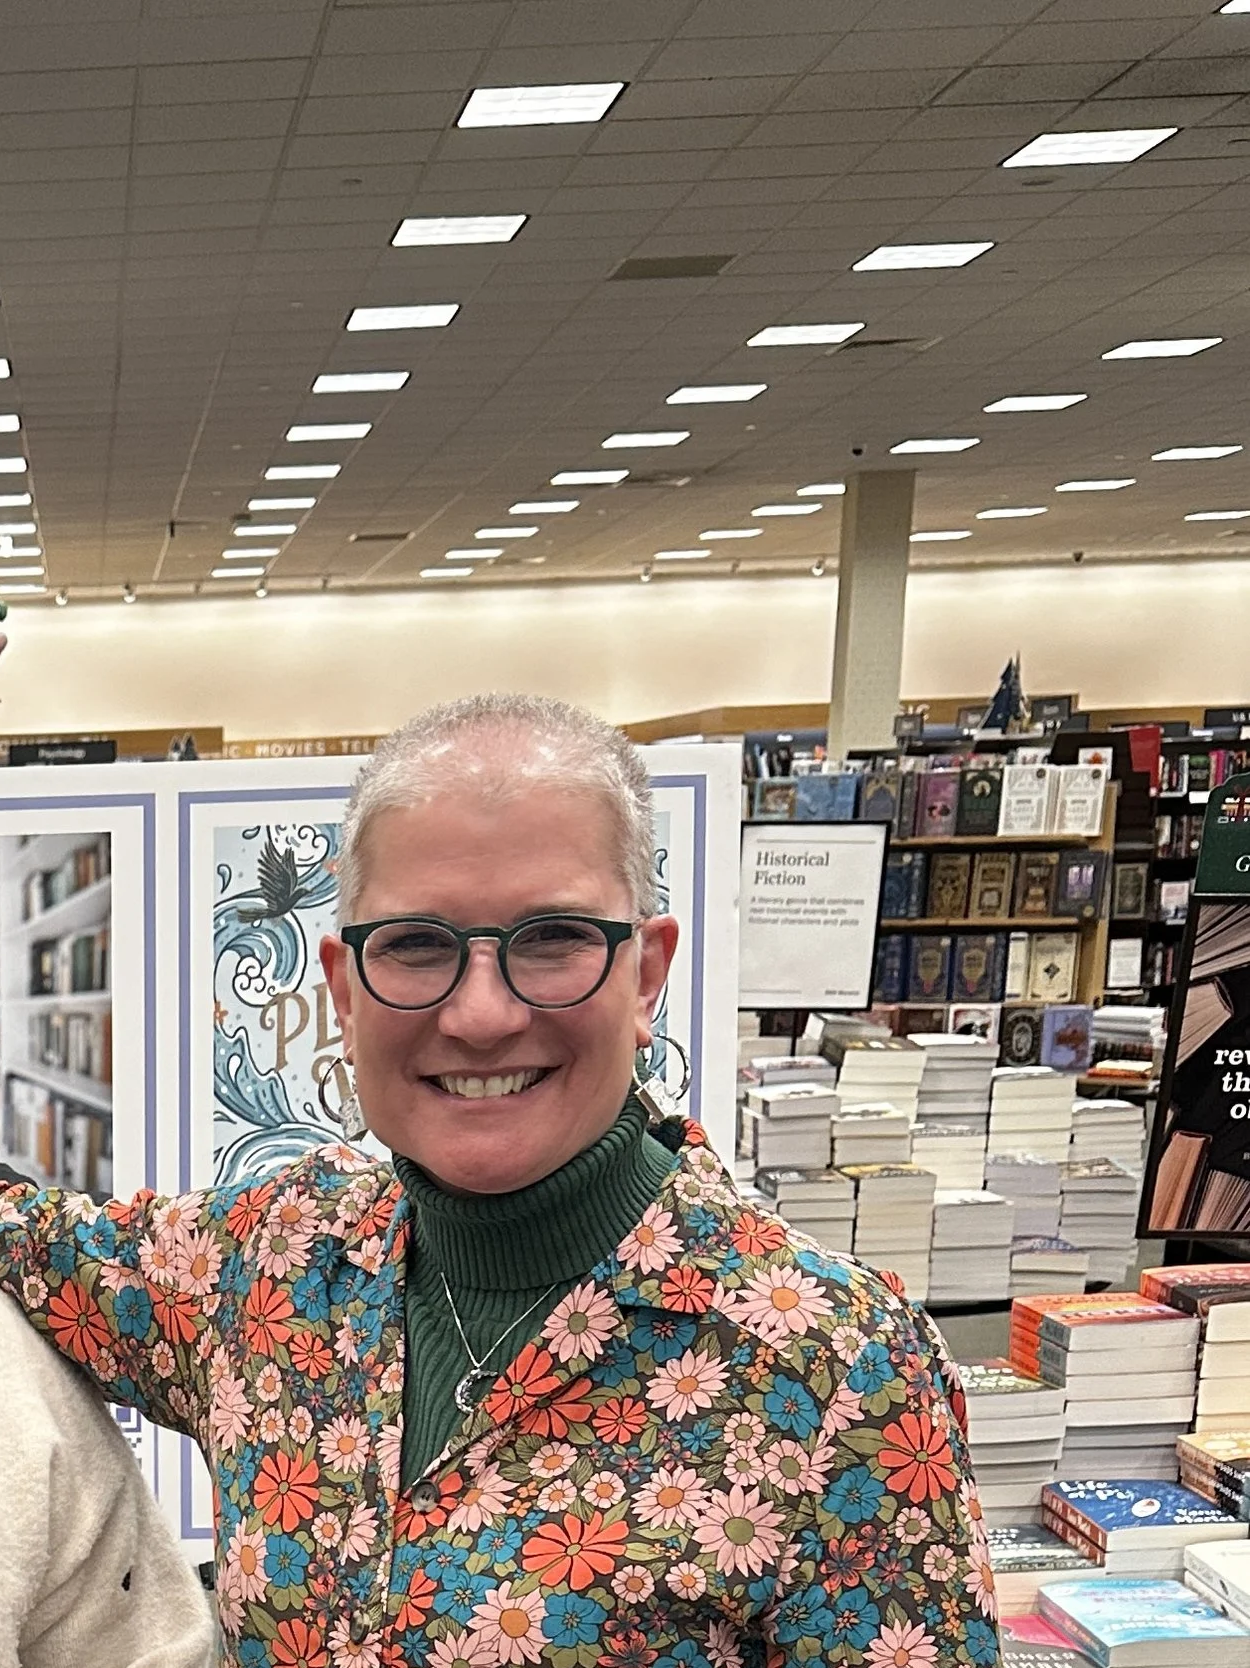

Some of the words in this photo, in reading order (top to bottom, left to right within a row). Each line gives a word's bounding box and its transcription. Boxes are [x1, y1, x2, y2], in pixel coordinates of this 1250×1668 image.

[756, 851, 830, 867] Historical
[754, 870, 806, 886] Fiction
[810, 896, 825, 905] that
